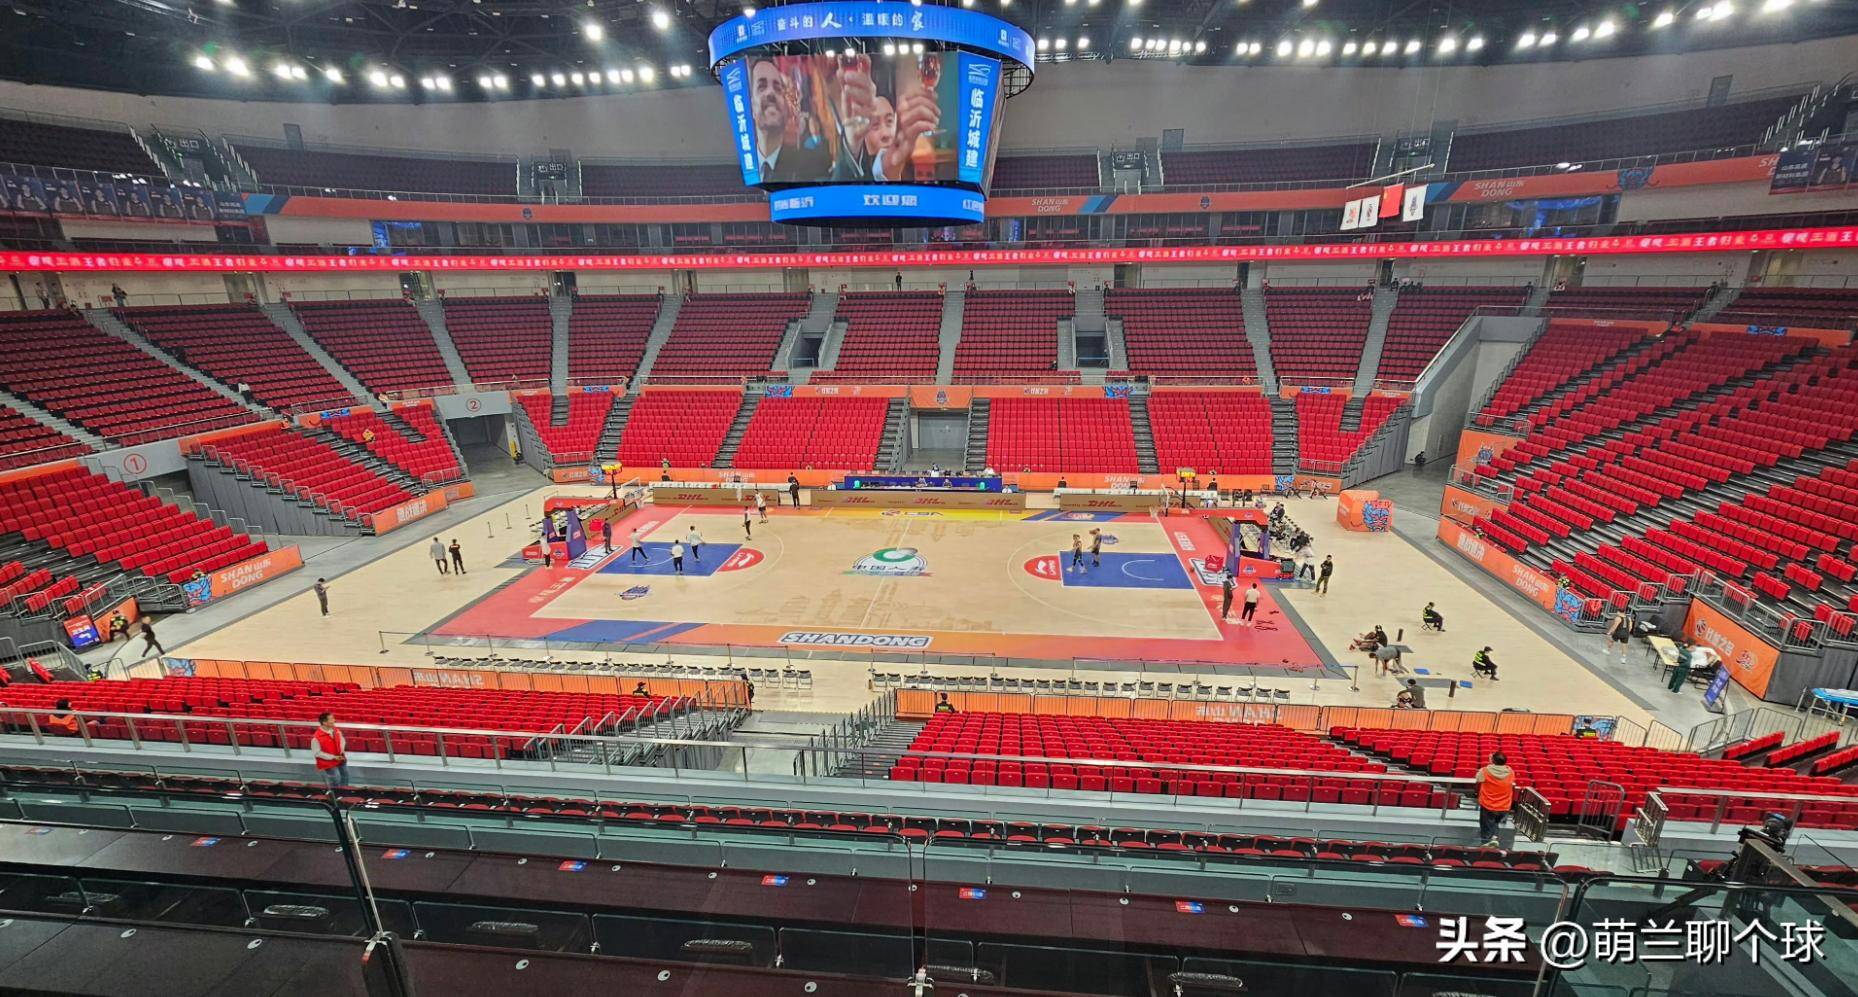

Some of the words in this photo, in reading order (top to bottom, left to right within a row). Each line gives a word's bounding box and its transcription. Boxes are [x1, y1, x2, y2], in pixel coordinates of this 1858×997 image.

[965, 88, 985, 168] 临沂城建
[1474, 180, 1506, 191] SHAN
[1481, 188, 1512, 197] DONG
[1031, 198, 1055, 206] SHAN
[1037, 205, 1061, 213] DONG
[677, 493, 705, 501] DHL
[221, 565, 254, 583] SHAN
[231, 571, 264, 589] DONG
[1512, 564, 1537, 585] SHAN
[1515, 576, 1540, 597] DONG
[783, 633, 927, 647] SHANDONG
